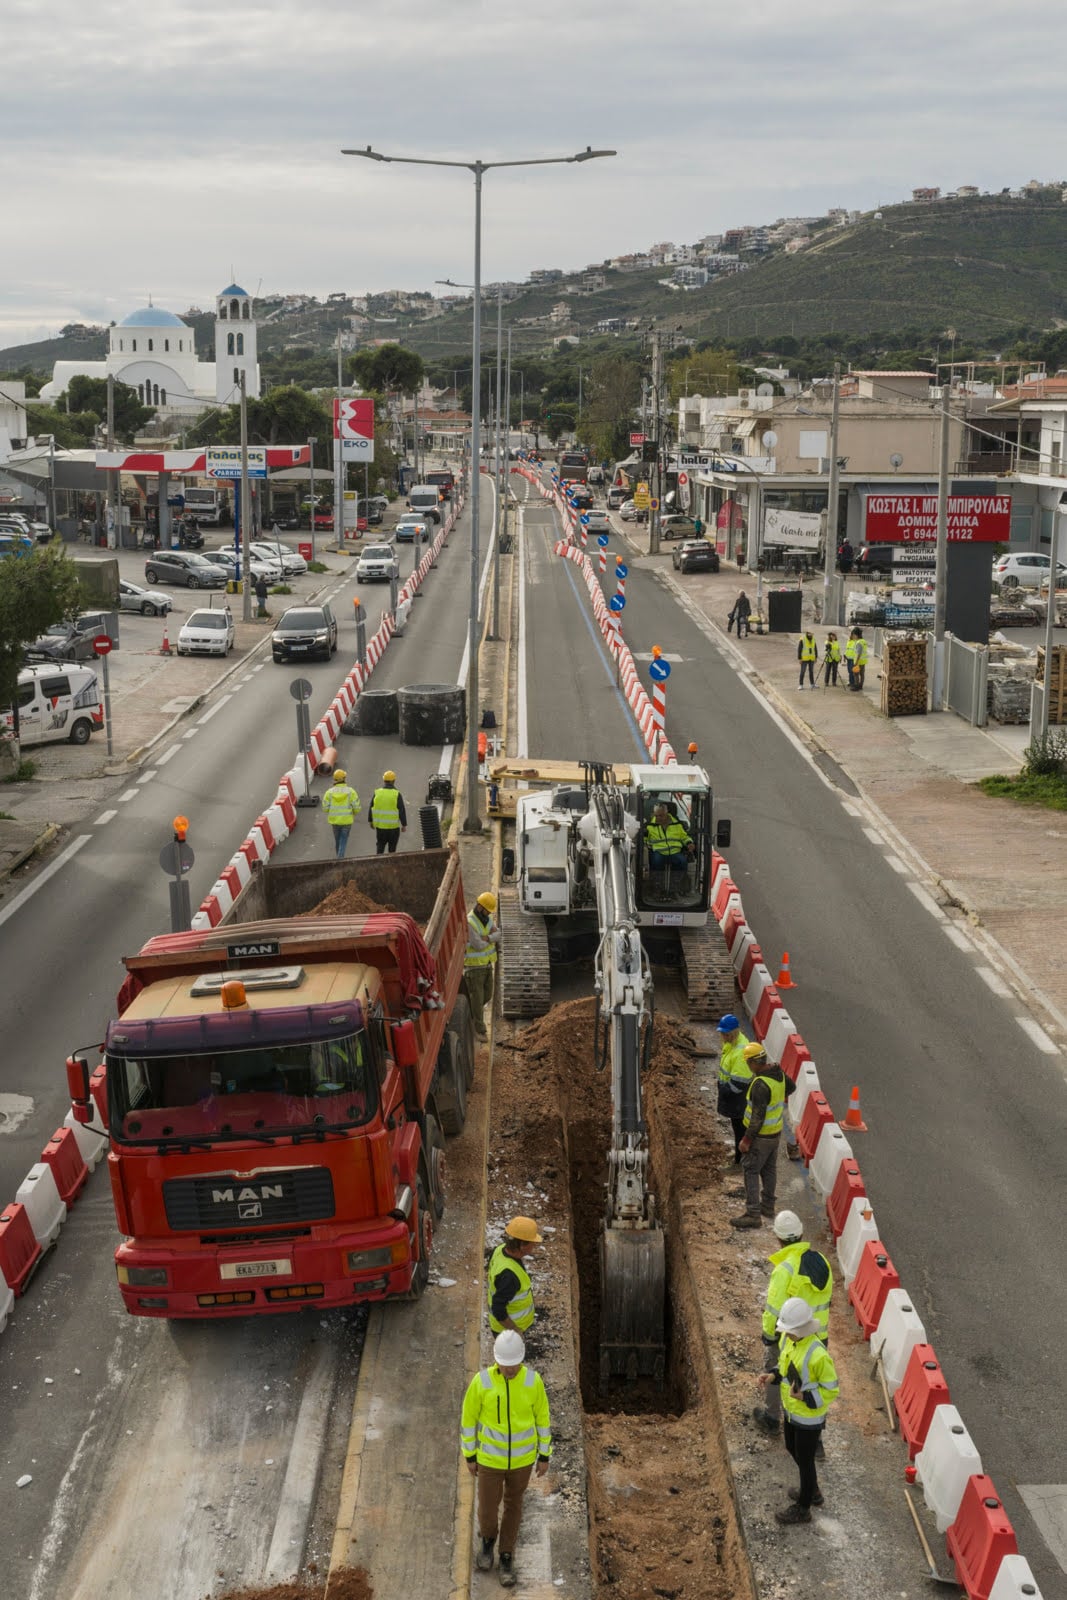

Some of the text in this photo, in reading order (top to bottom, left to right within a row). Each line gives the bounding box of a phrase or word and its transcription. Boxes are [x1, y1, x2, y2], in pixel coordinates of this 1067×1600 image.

[207, 450, 264, 463] Γαλαξας
[217, 469, 242, 477] PARKIN
[868, 498, 911, 514] ΚΩΣΤΑΣ
[922, 498, 1009, 514] ΜΠΜΠΙΡΟΥΛΑΣ
[234, 945, 272, 956] MAN
[212, 1185, 283, 1202] MAN
